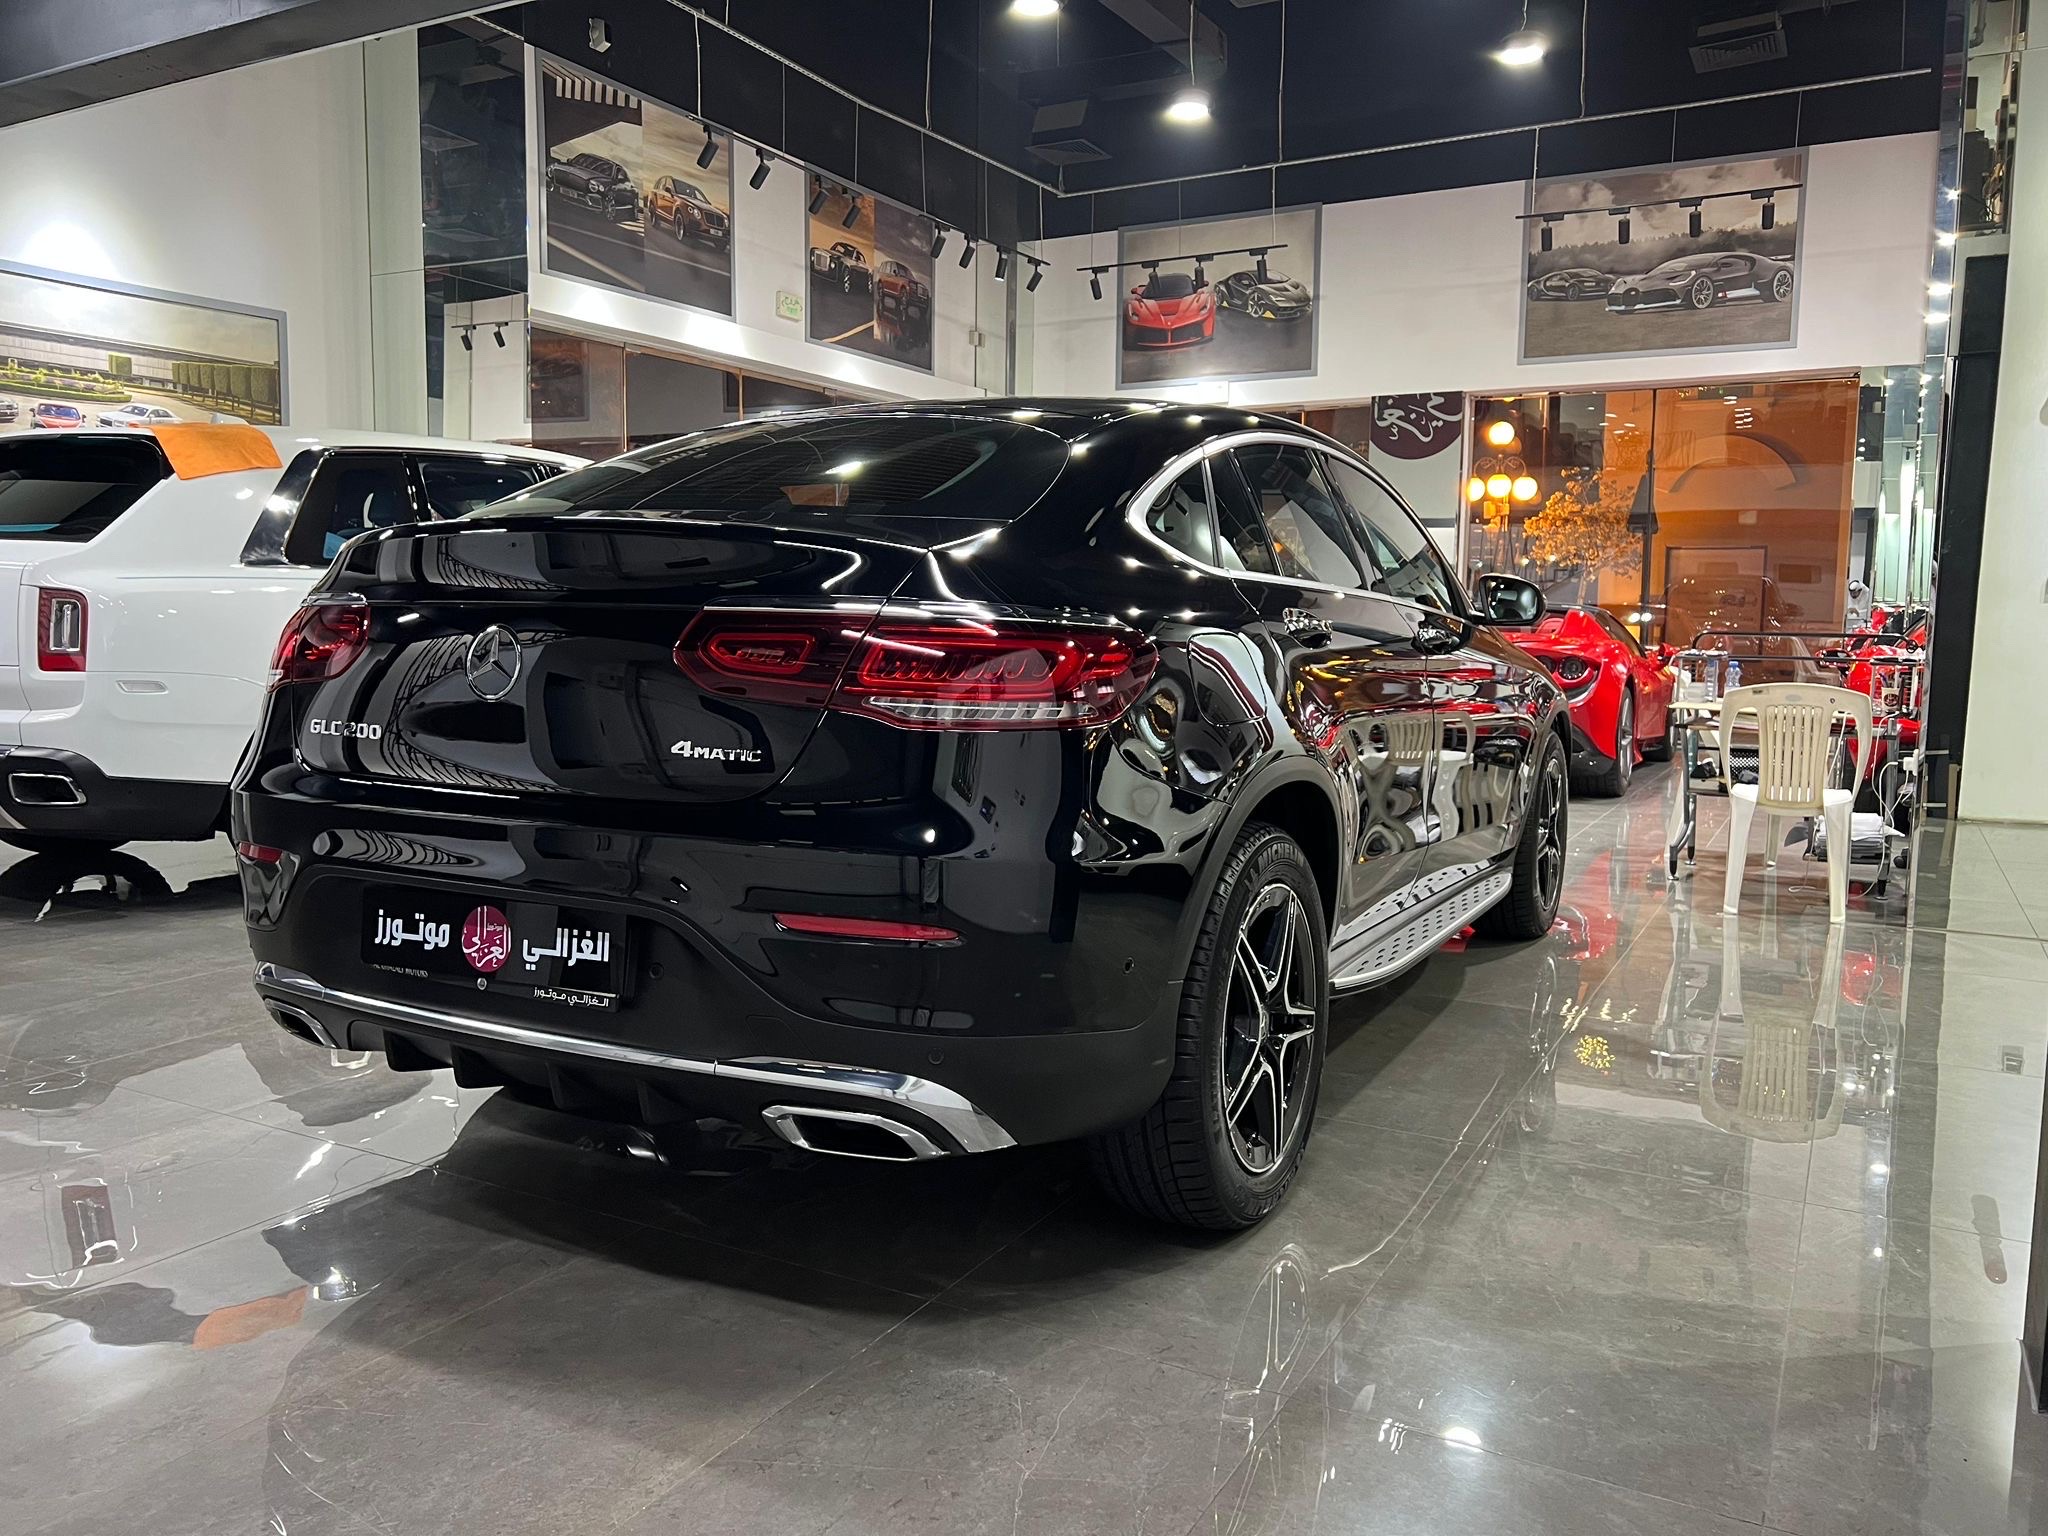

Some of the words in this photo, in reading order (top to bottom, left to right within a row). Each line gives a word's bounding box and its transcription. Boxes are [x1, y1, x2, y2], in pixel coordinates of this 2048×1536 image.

[310, 718, 342, 736] GLC
[343, 721, 382, 740] 200
[670, 740, 762, 762] 4MATIC
[1257, 842, 1304, 873] MICHELIN
[374, 908, 450, 951] موتورز
[522, 927, 610, 971] الغزالي
[533, 986, 567, 1001] موتورز
[567, 994, 609, 1007] الغزالي
